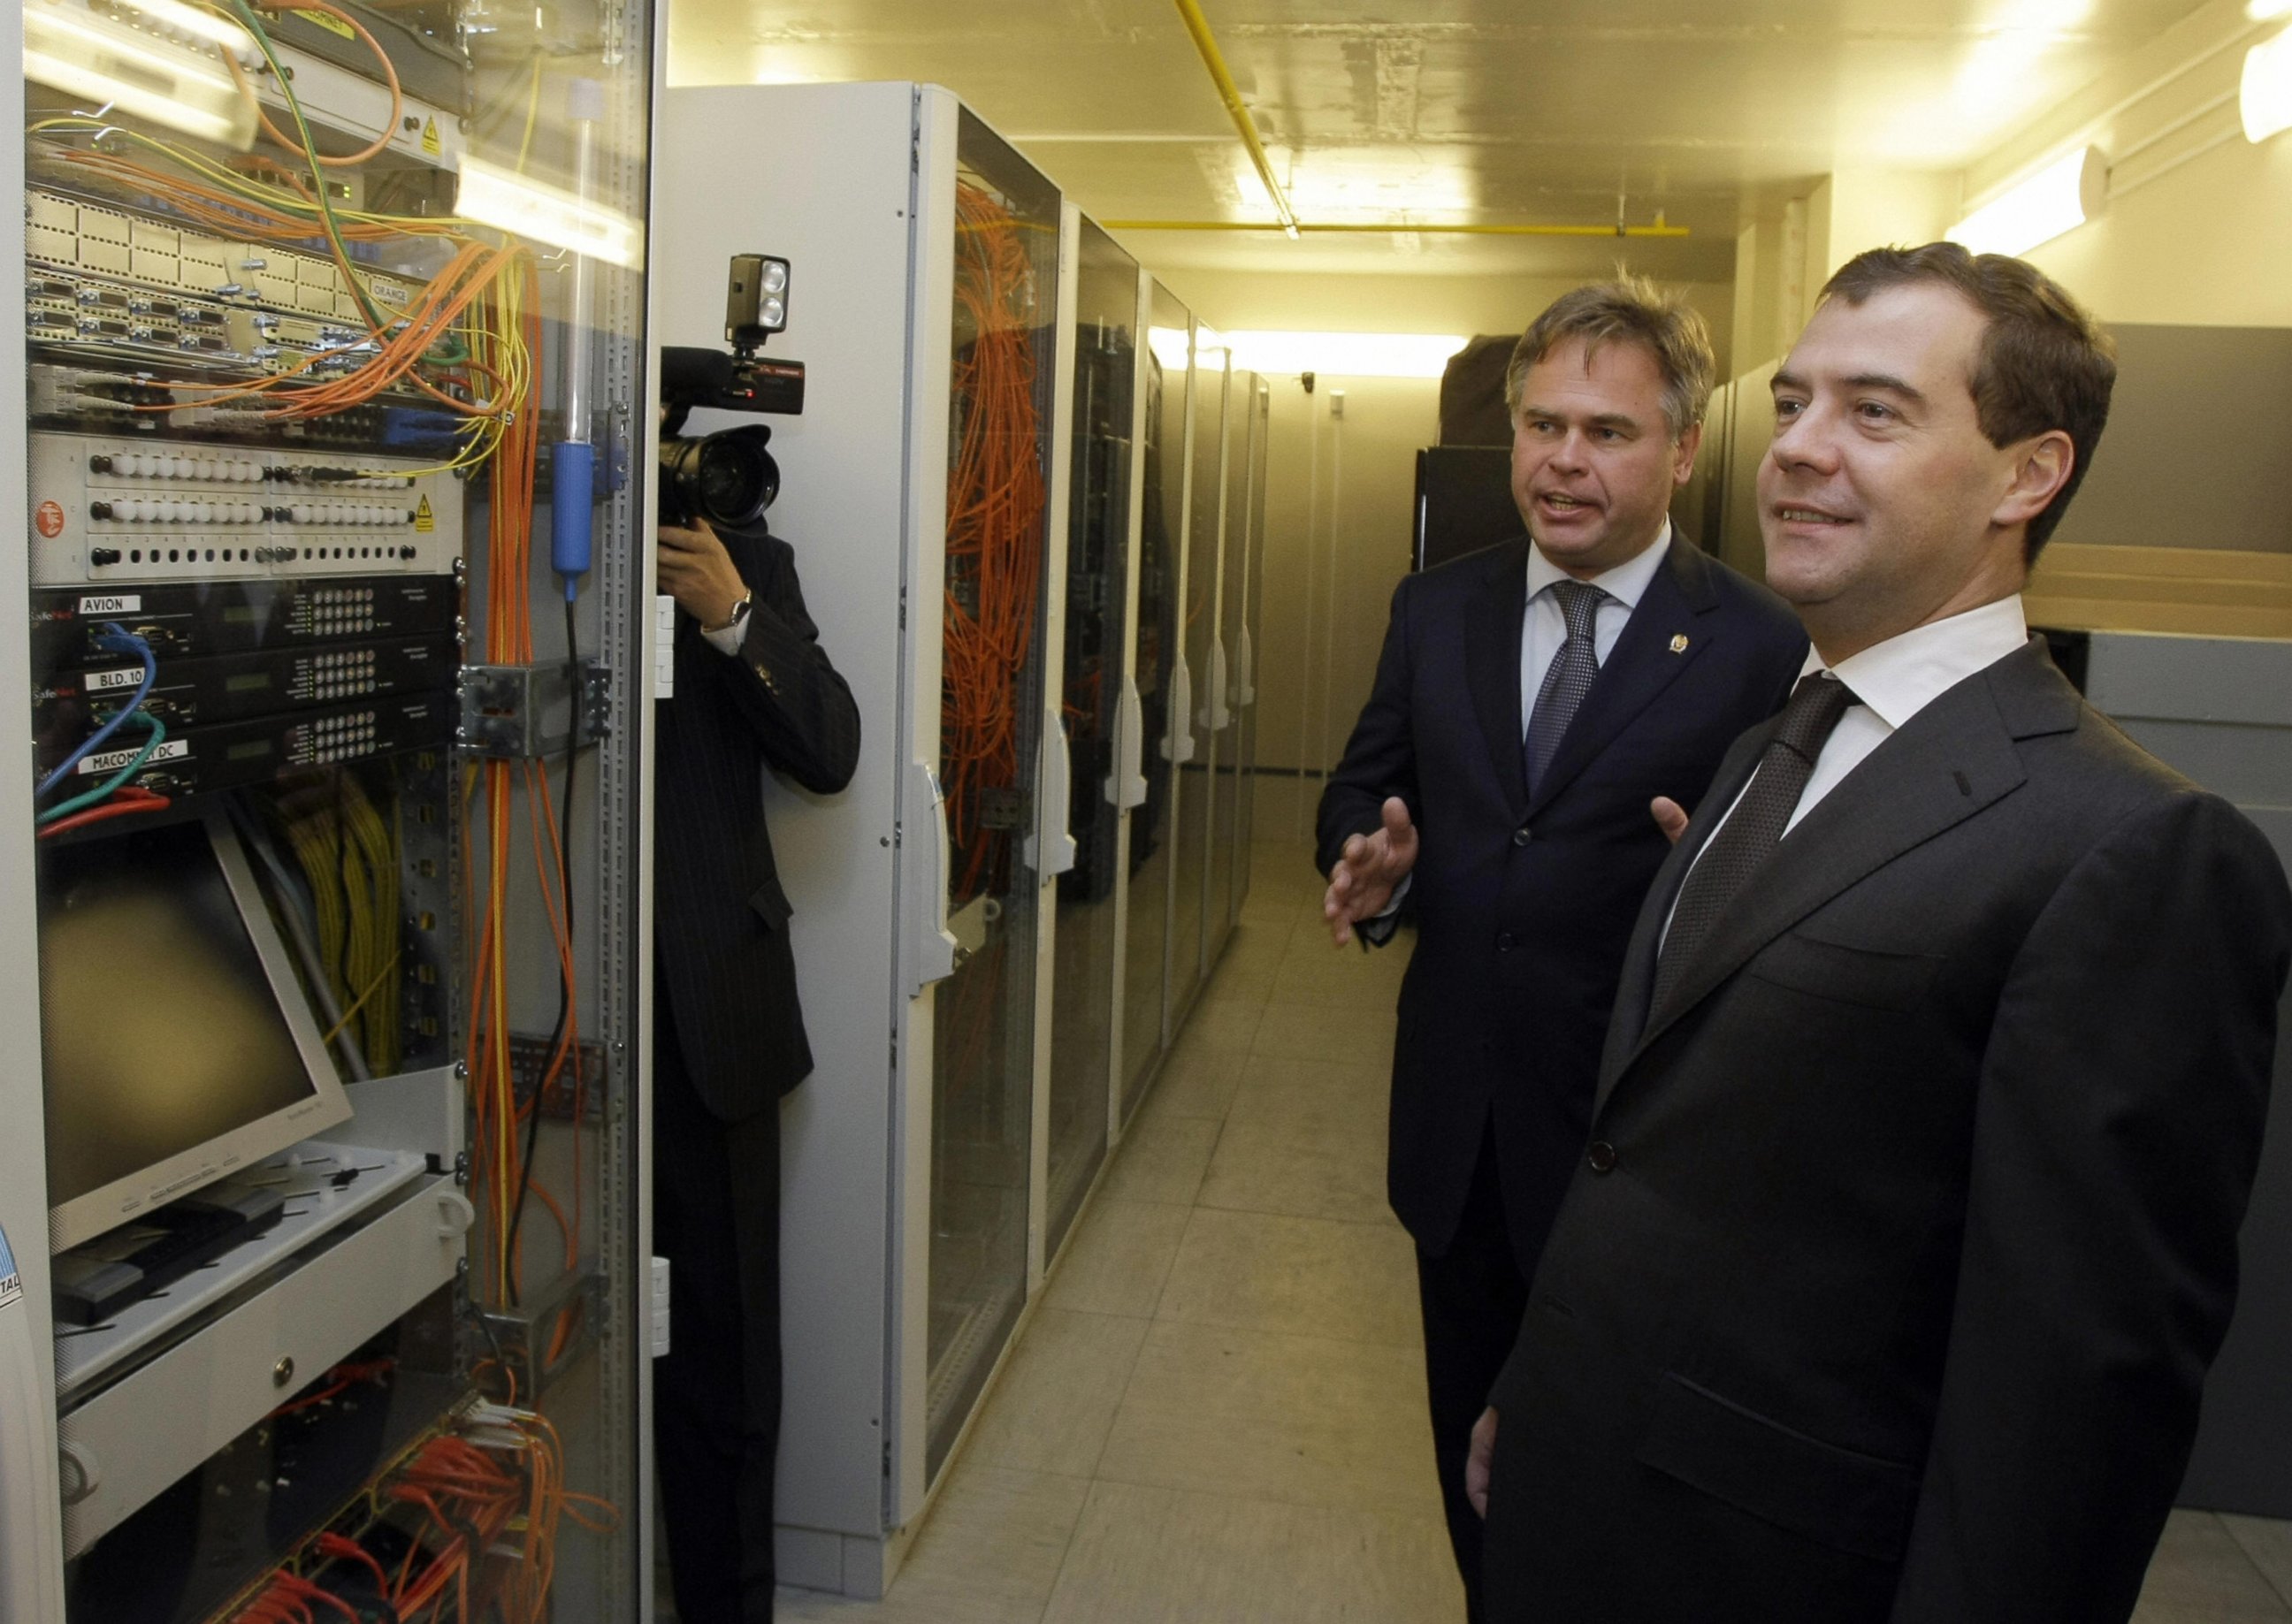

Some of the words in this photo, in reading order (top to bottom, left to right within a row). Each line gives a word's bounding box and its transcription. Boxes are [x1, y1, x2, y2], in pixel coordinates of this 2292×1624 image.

[373, 285, 406, 301] ORANGE
[84, 598, 123, 612] AVION
[100, 673, 127, 687] BLD.
[131, 670, 142, 682] 10
[93, 748, 156, 769] MACOMT
[158, 744, 173, 758] DC
